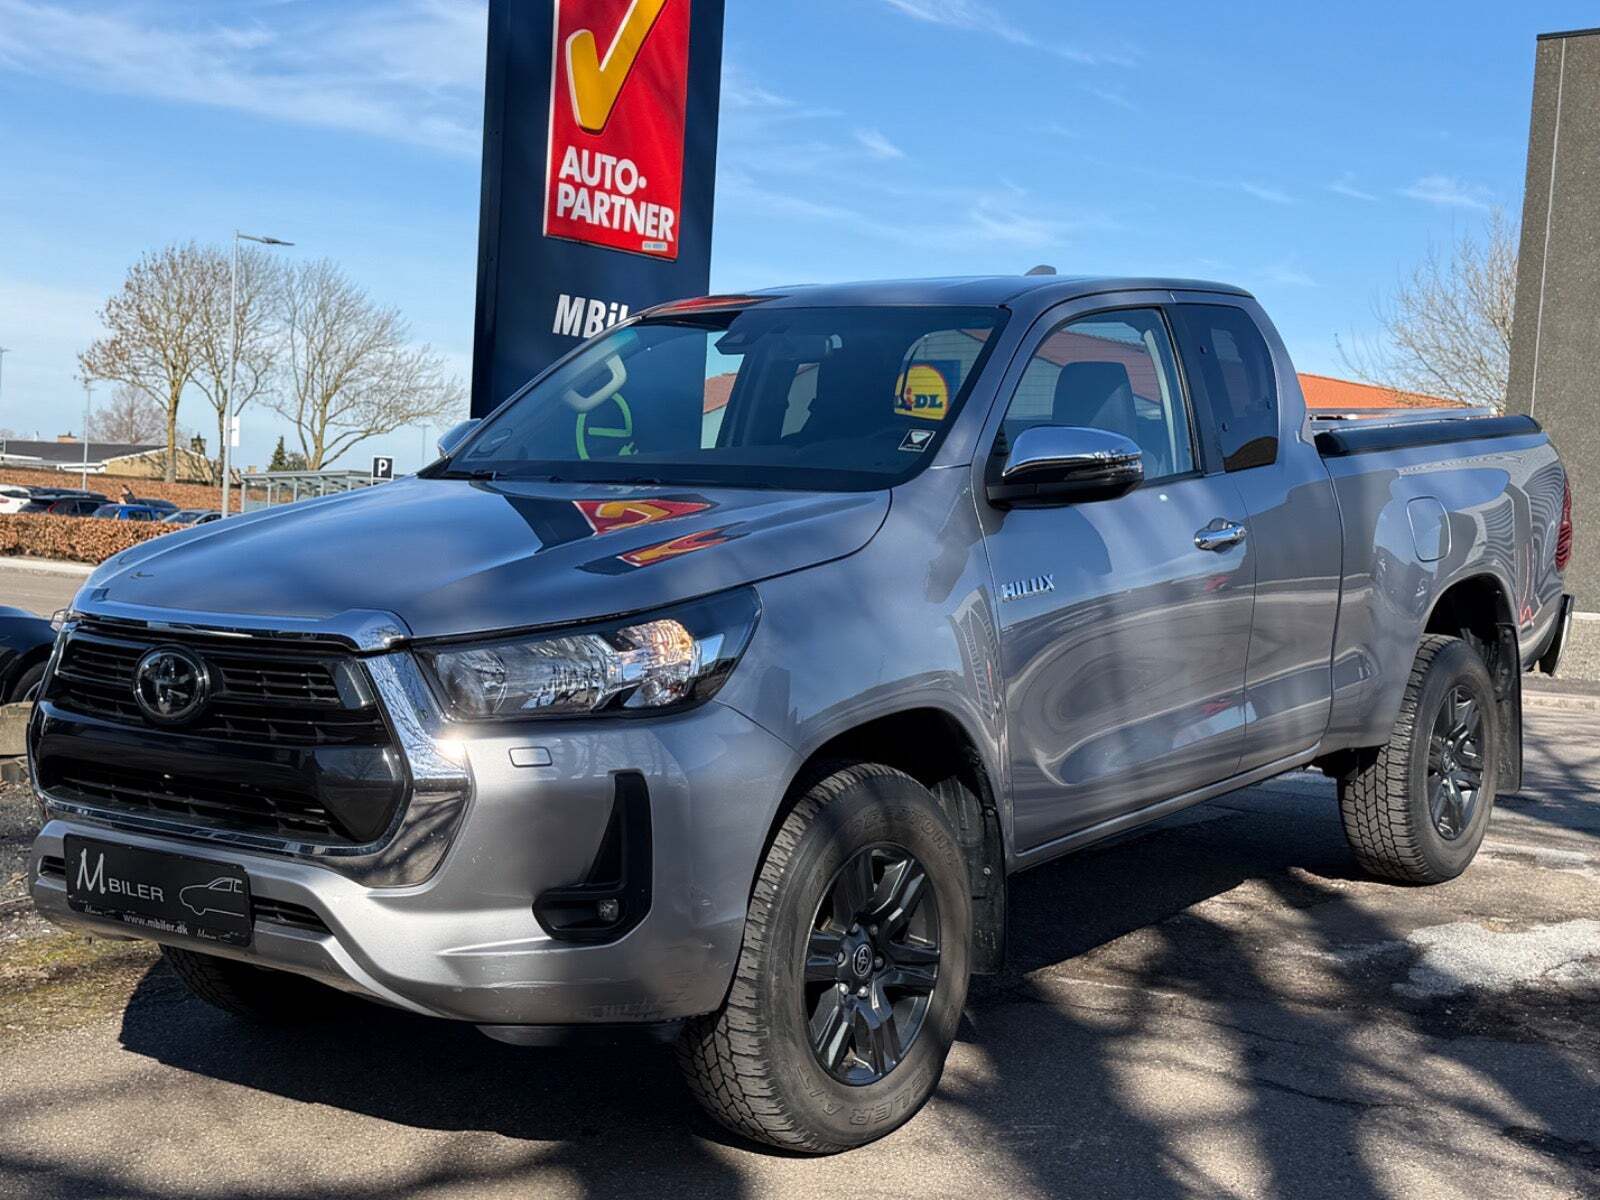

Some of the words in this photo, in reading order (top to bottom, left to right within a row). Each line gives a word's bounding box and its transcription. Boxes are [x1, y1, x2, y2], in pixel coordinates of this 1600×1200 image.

[557, 182, 674, 242] PARTNER
[378, 459, 388, 477] P
[1001, 574, 1056, 599] HILUX
[123, 913, 188, 935] www.mbiler.dk
